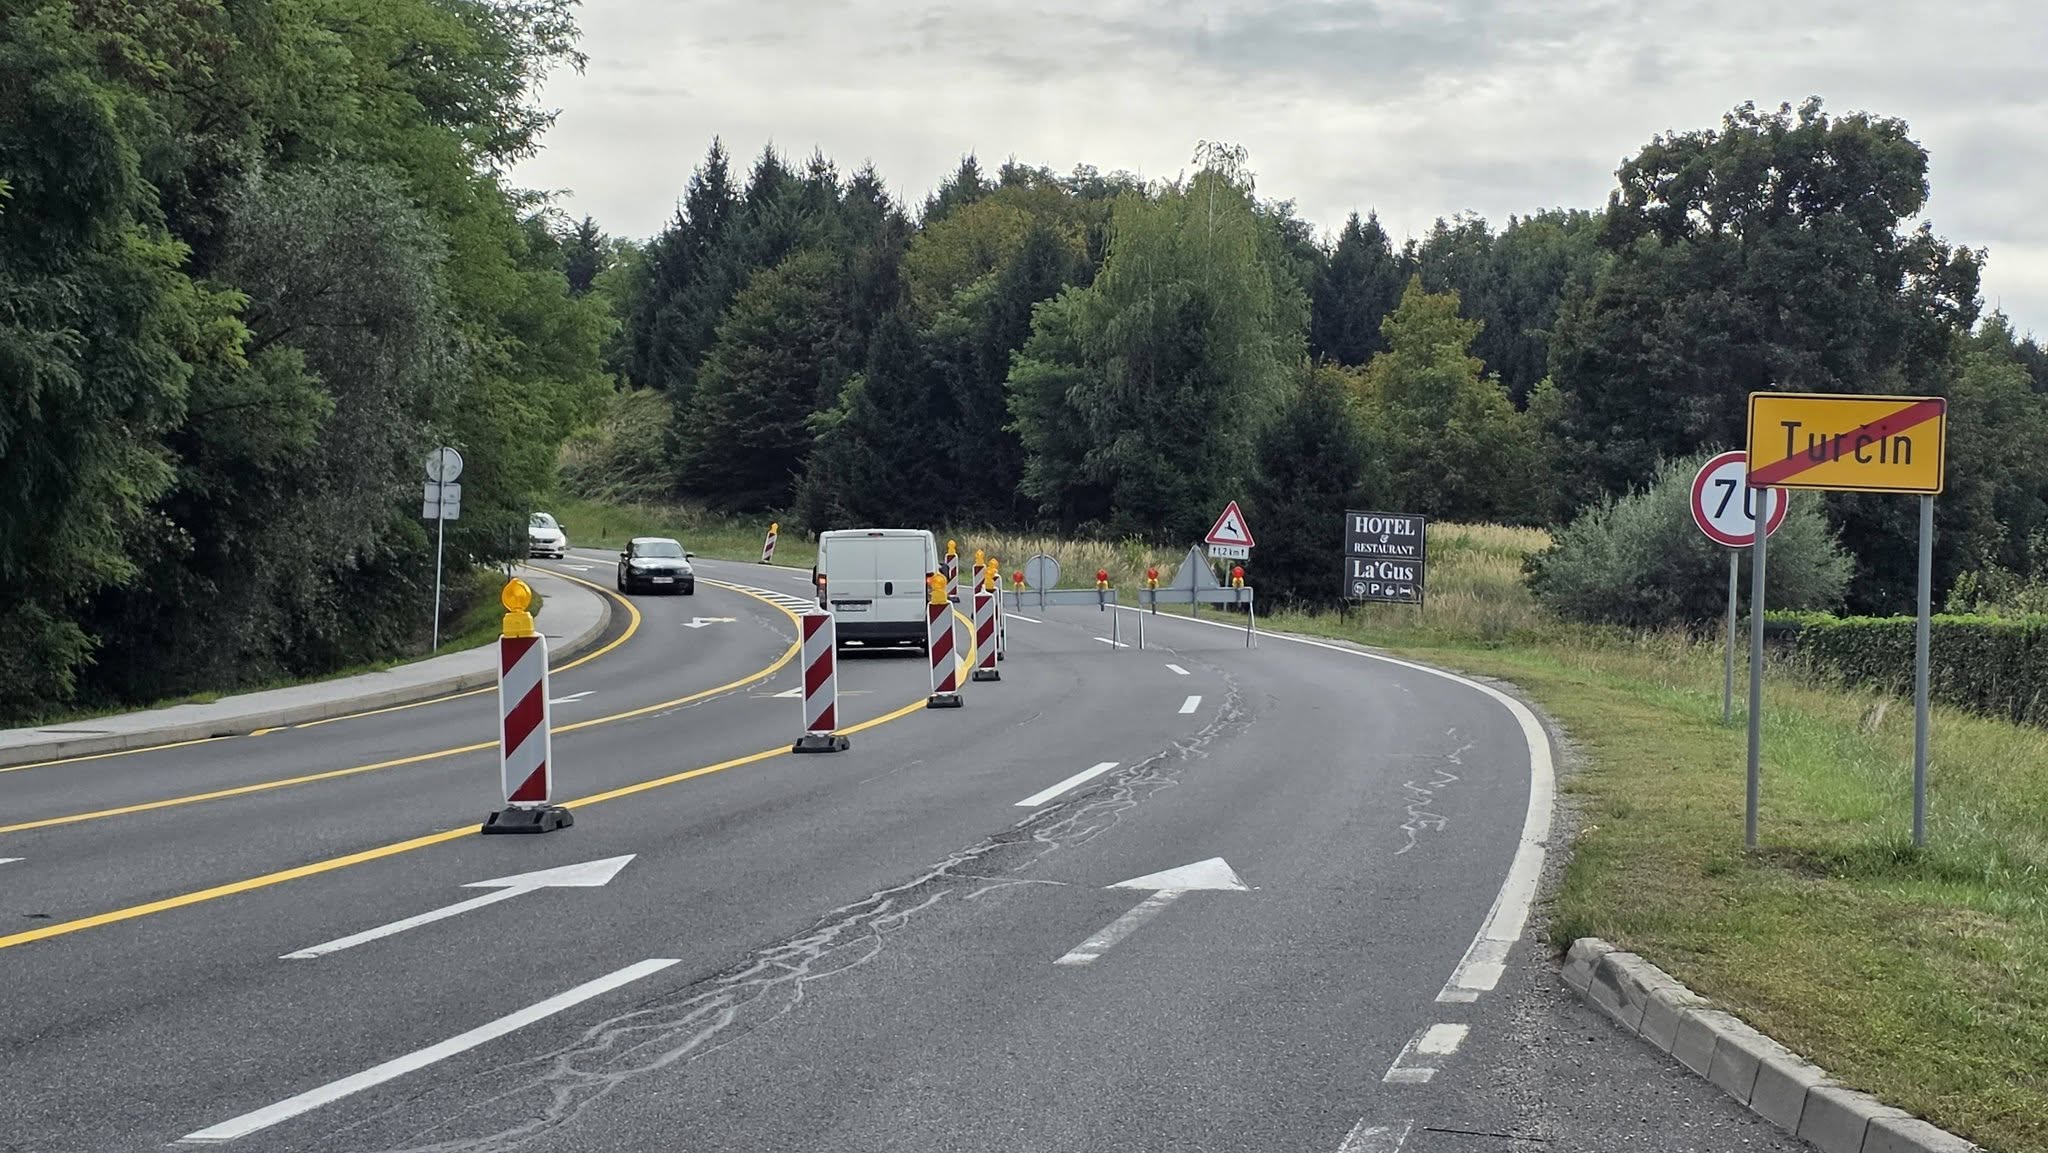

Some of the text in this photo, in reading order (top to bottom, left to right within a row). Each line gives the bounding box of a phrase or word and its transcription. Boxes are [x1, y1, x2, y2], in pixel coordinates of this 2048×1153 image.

[1780, 420, 1912, 465] Turčin
[1355, 516, 1415, 536] HOTEL
[1380, 534, 1390, 543] &
[1354, 542, 1415, 555] RESTAURANT
[1353, 560, 1414, 580] La'Gus
[1370, 583, 1380, 594] P
